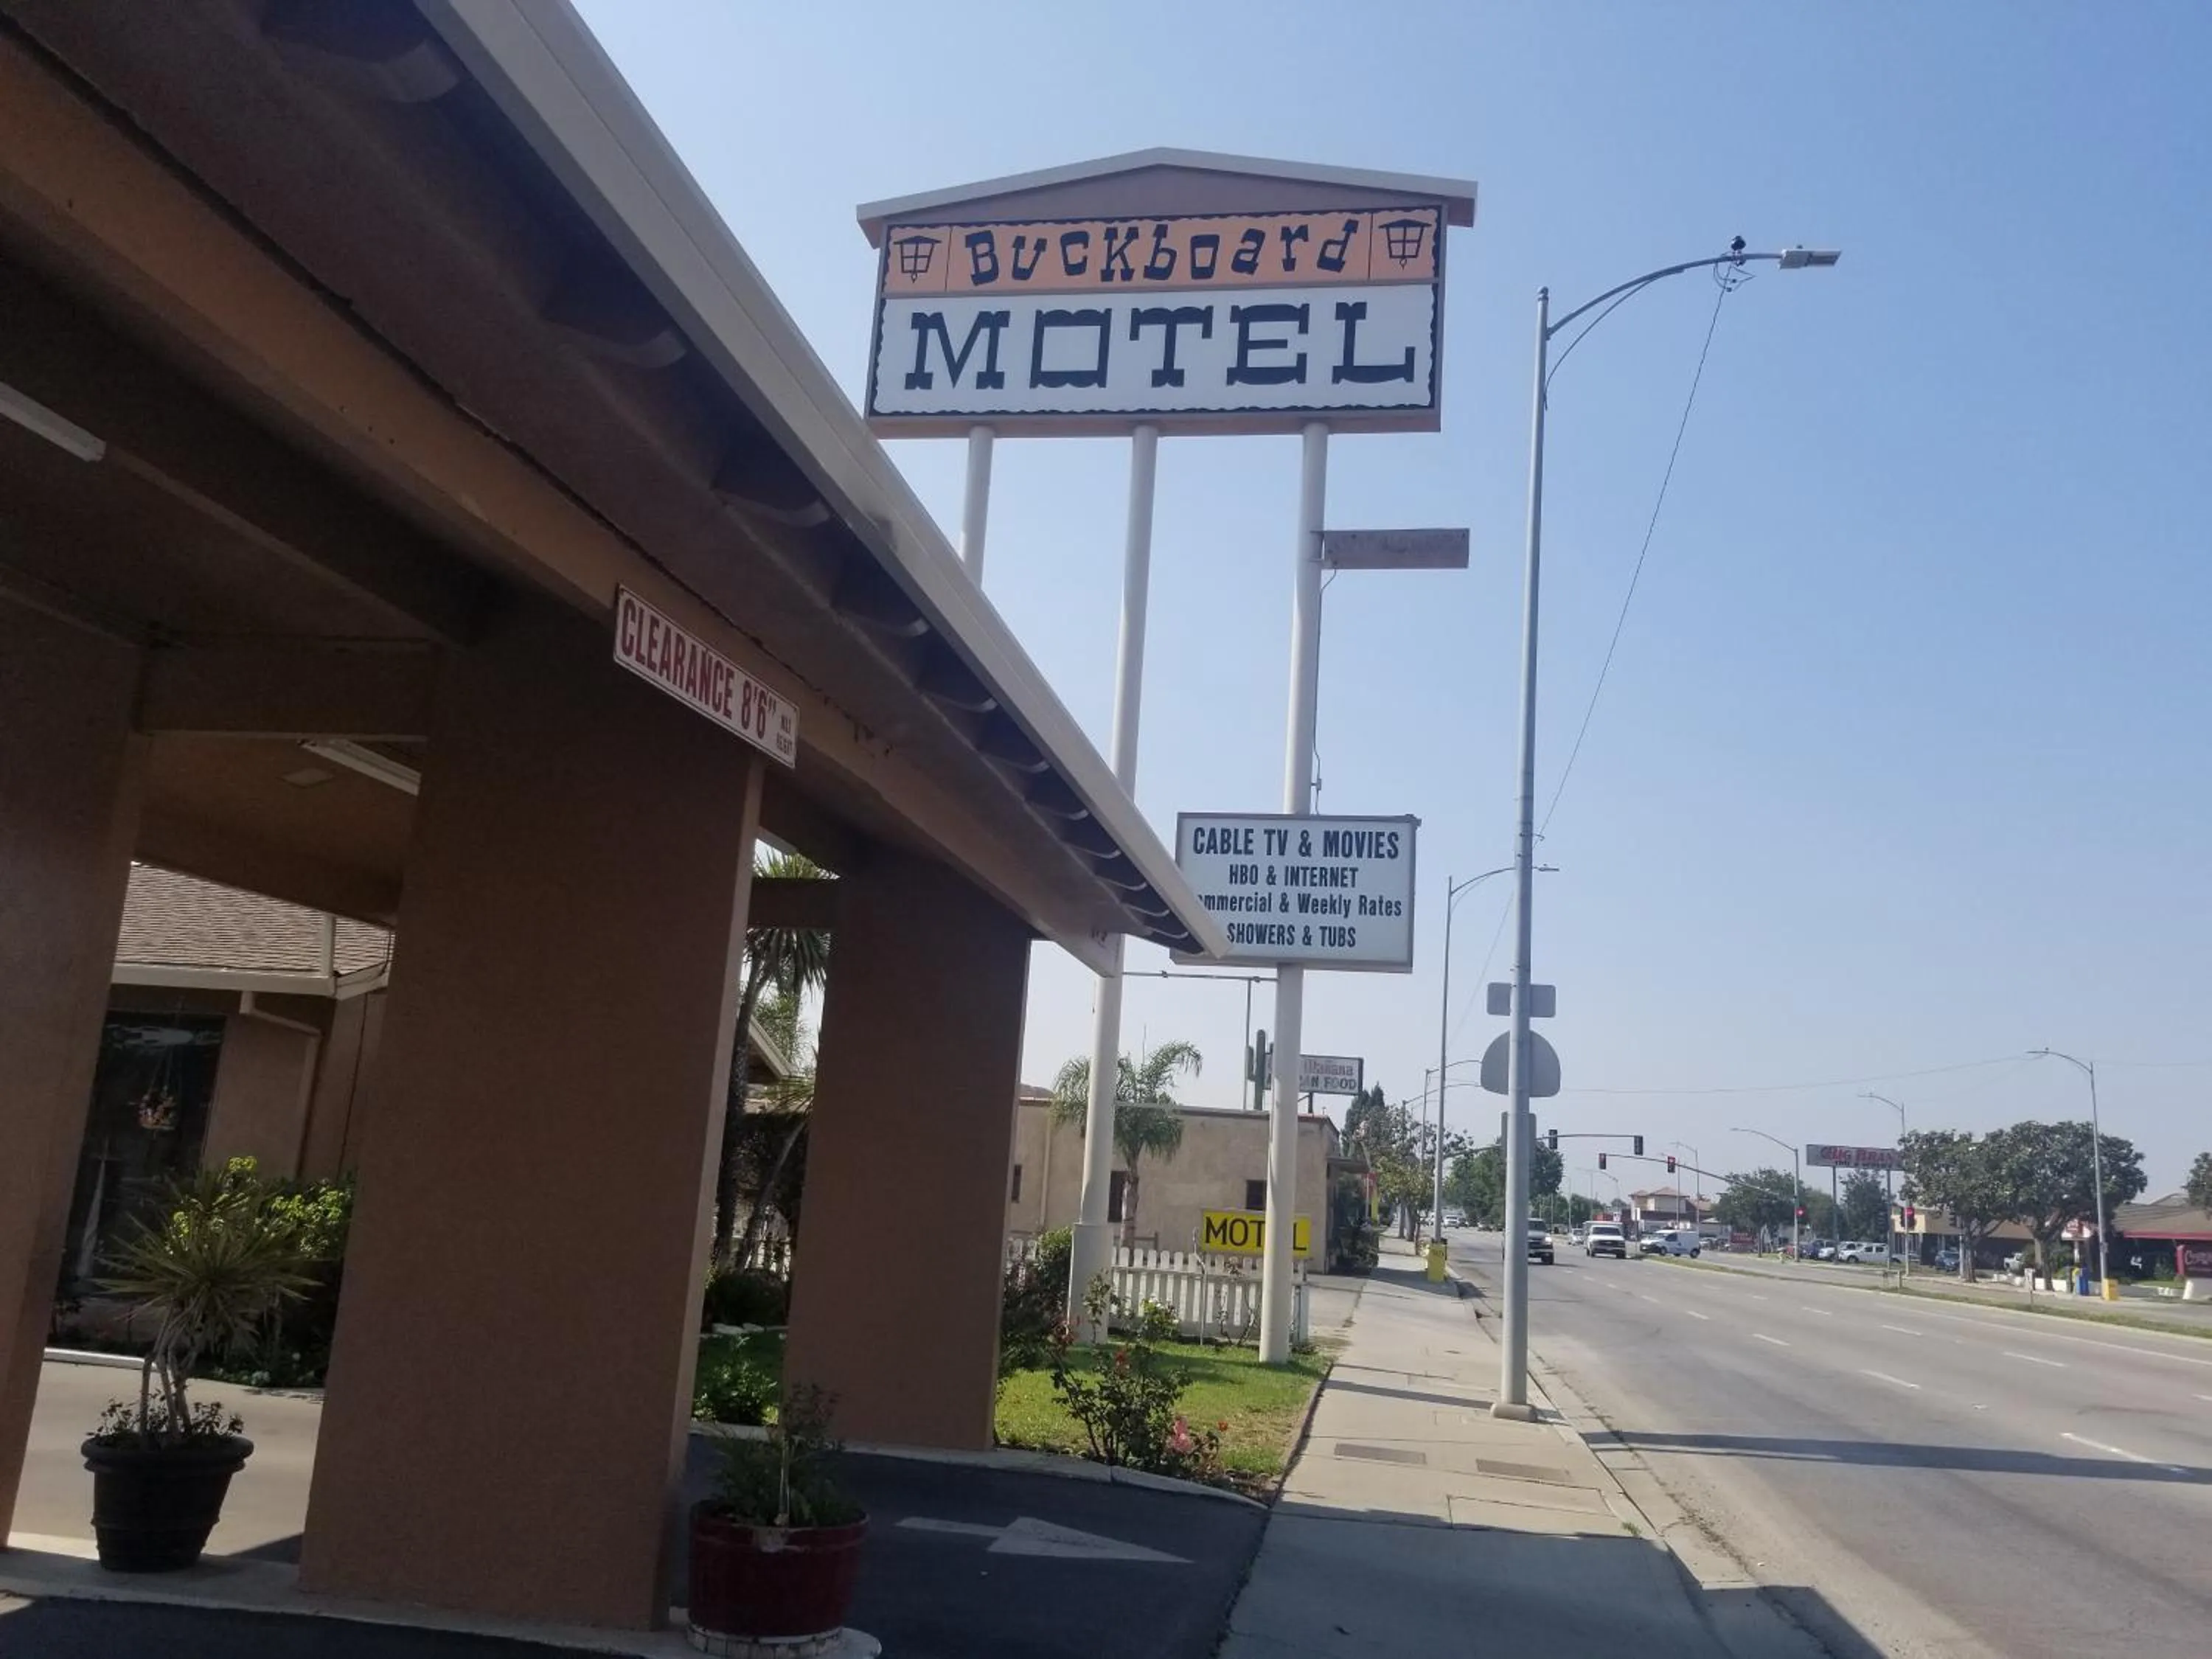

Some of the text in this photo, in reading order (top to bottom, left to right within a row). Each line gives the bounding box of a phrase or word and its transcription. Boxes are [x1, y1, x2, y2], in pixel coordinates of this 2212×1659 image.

[904, 302, 1416, 390] MOTEL
[621, 598, 735, 721] CLEARANCE
[1193, 827, 1399, 859] CABLE TV & MOVIES
[1229, 864, 1359, 888] HBO & INTERNET
[1197, 891, 1402, 919] mmercial & Weekly Rates
[1227, 922, 1357, 948] SHOWERS & TUBS
[1204, 1216, 1307, 1251] MOTL
